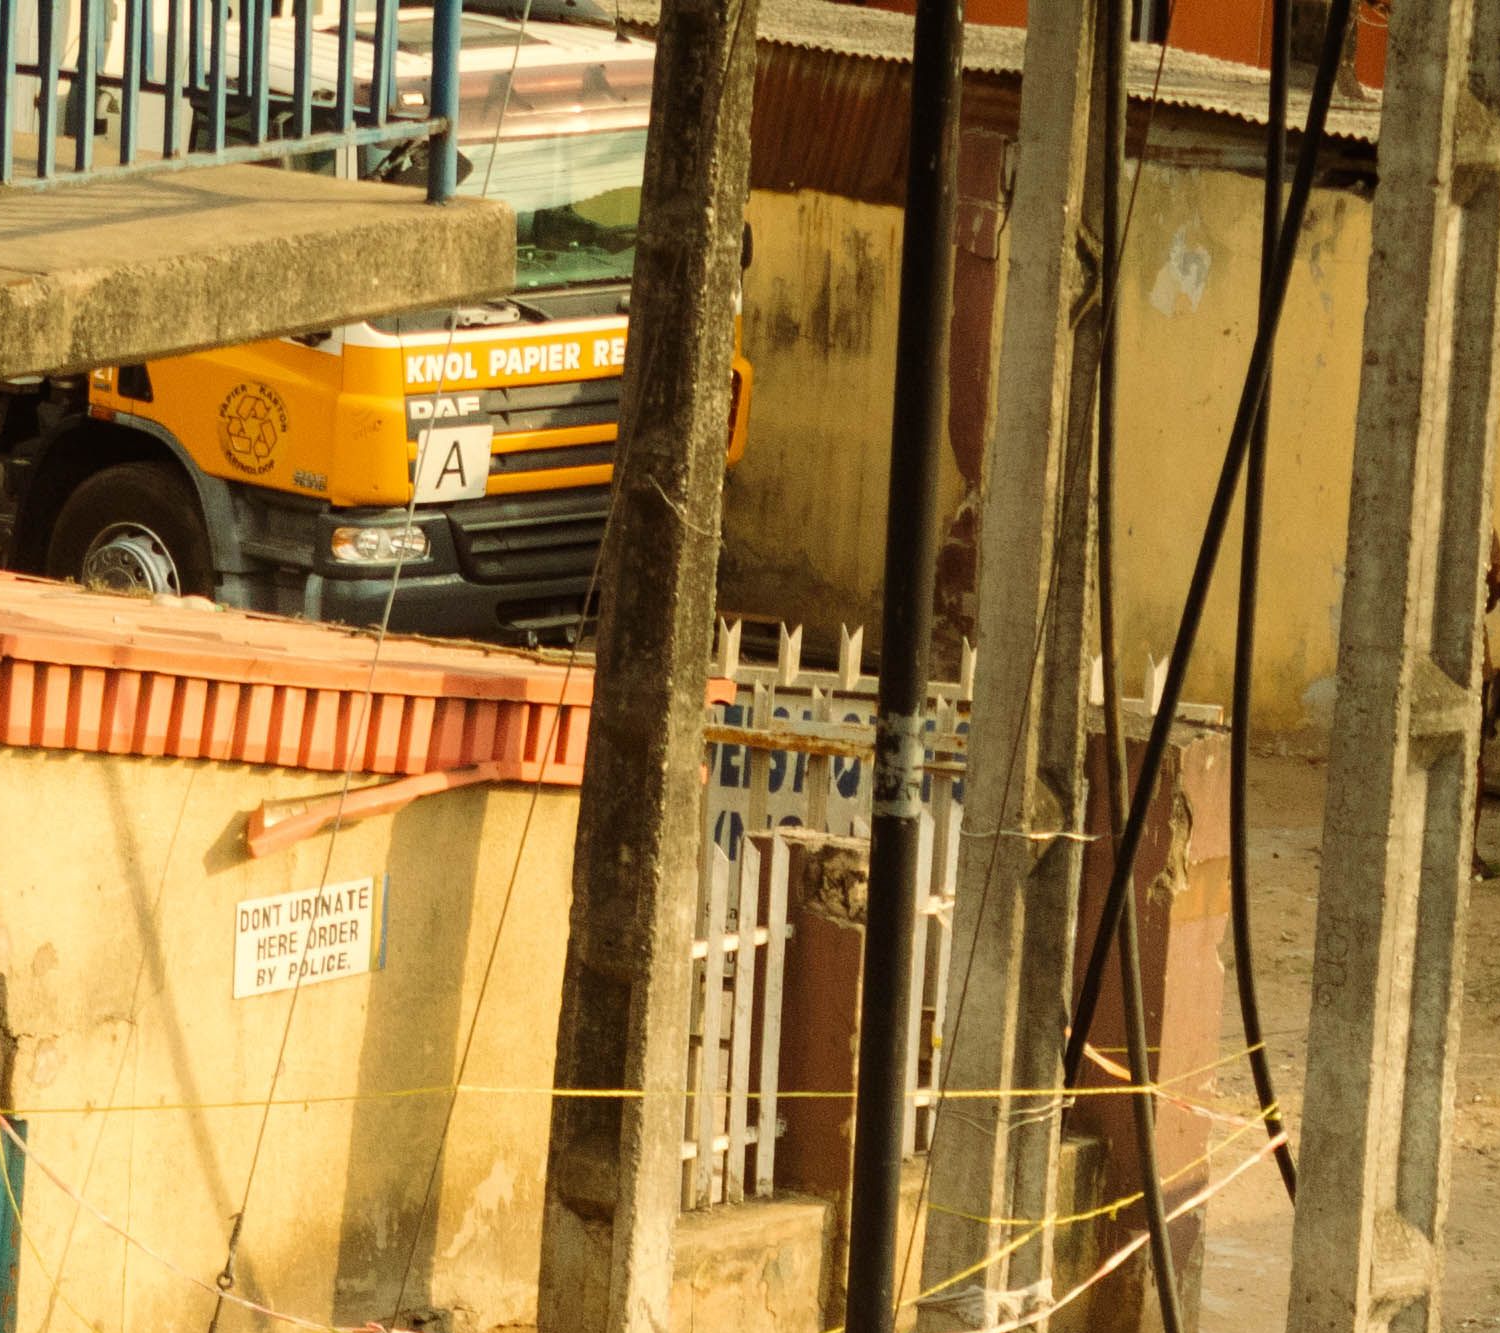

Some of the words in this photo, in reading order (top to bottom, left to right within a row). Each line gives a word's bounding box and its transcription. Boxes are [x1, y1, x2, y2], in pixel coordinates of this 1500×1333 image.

[407, 351, 478, 384] KNOL
[489, 342, 581, 377] PAPIER
[593, 337, 626, 367] RE
[409, 396, 480, 419] DAF
[435, 440, 467, 489] A
[240, 904, 282, 933] DONT
[289, 886, 369, 922] URINATE
[257, 931, 299, 961] HERE
[307, 919, 359, 950] ORDER
[256, 967, 277, 987] BY
